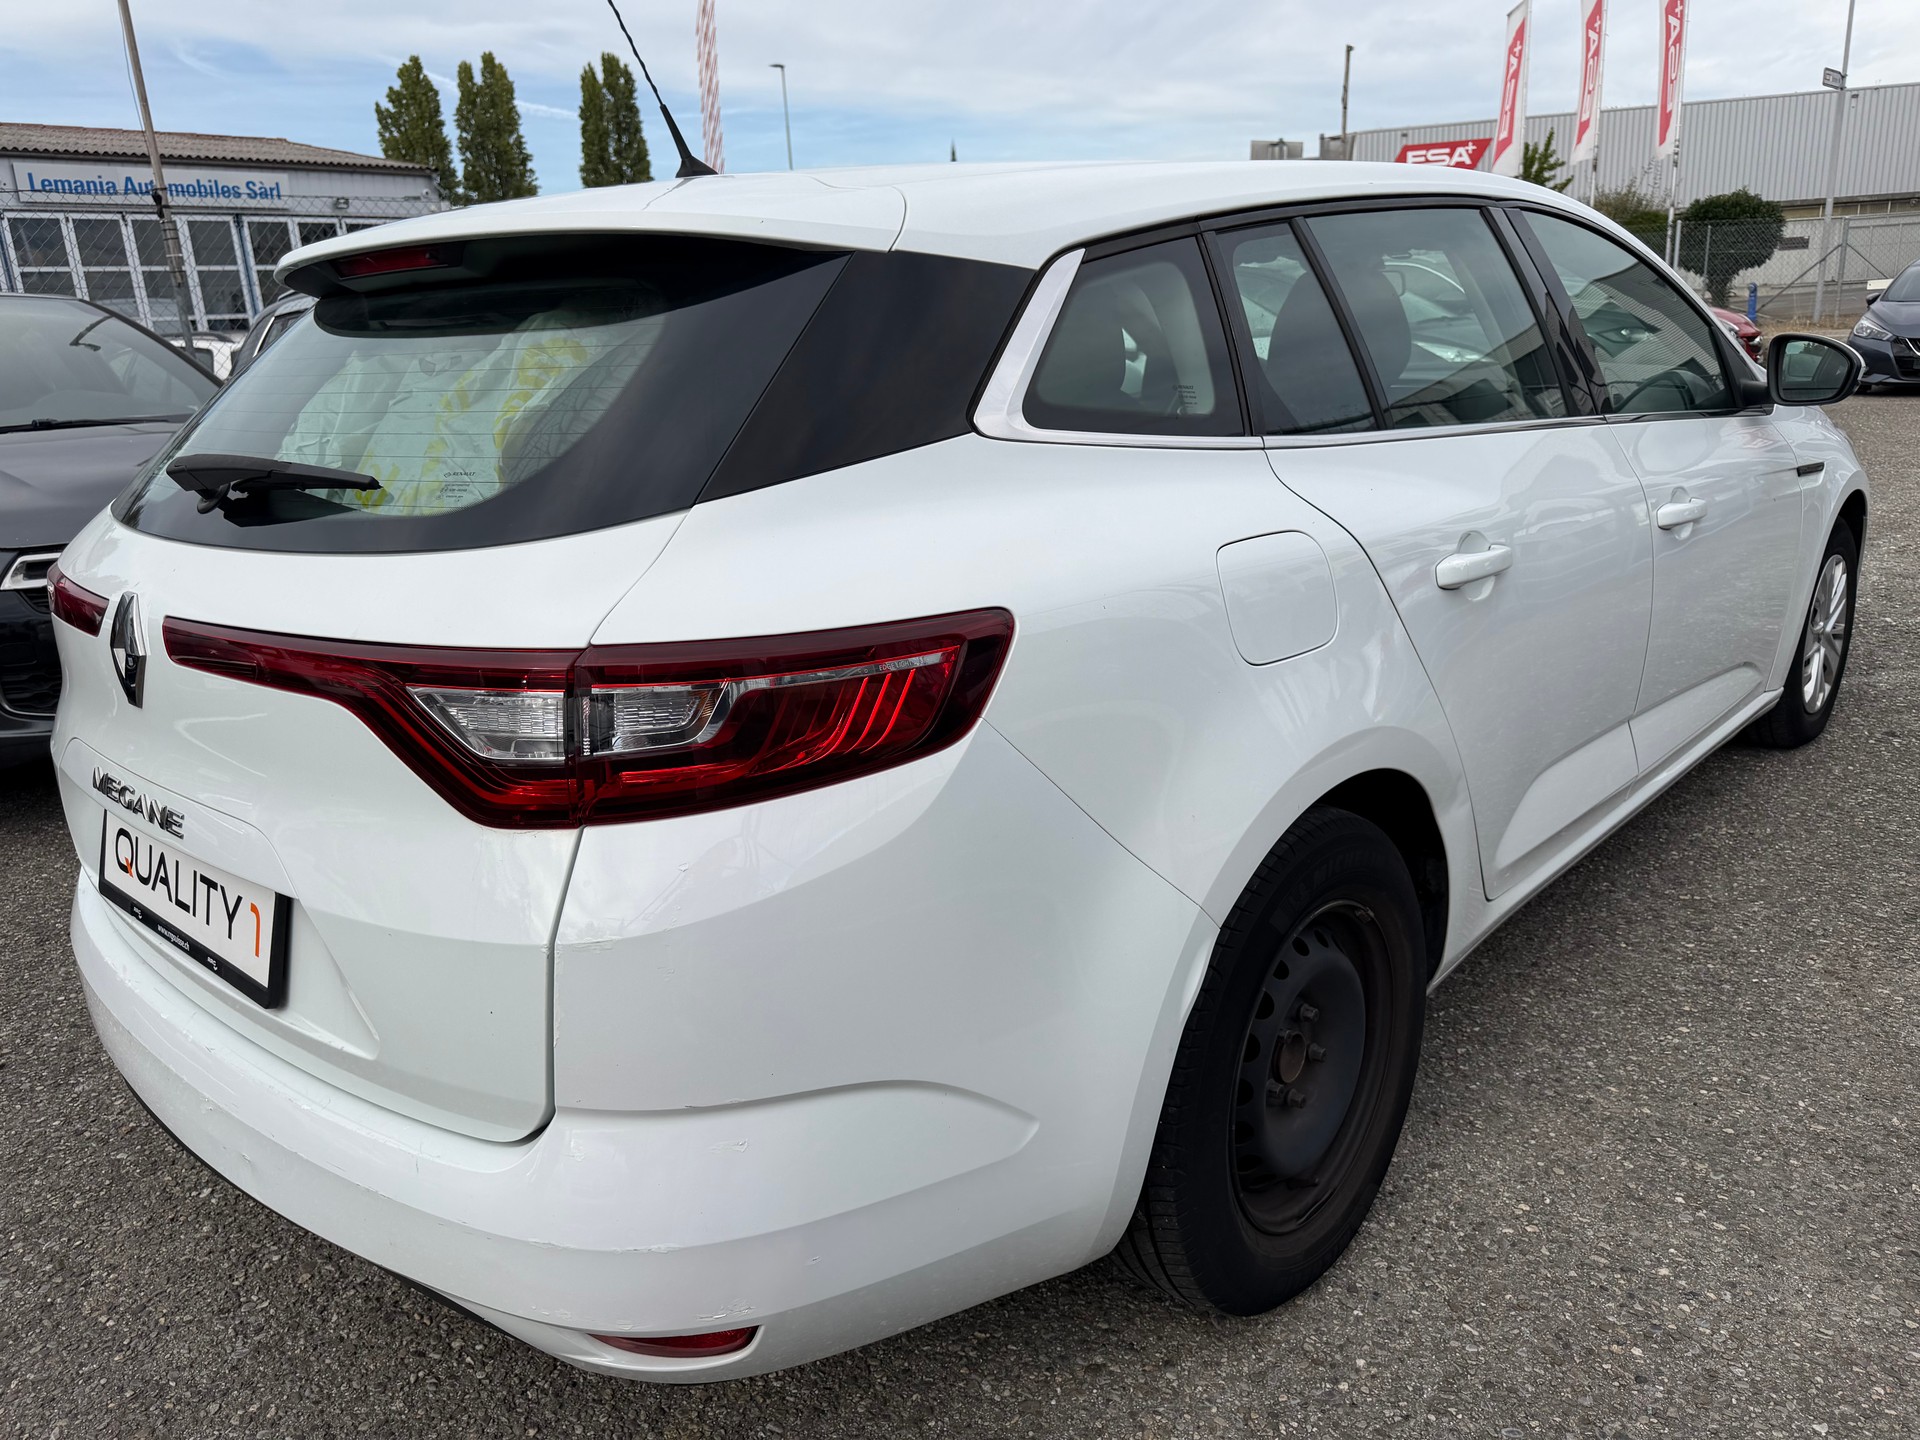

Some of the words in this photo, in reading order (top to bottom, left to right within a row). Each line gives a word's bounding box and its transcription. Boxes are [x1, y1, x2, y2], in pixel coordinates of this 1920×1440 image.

[27, 172, 117, 195] Lemania
[244, 180, 282, 200] Sàrl
[92, 767, 185, 839] MEGANE
[115, 827, 243, 940] QUALITY
